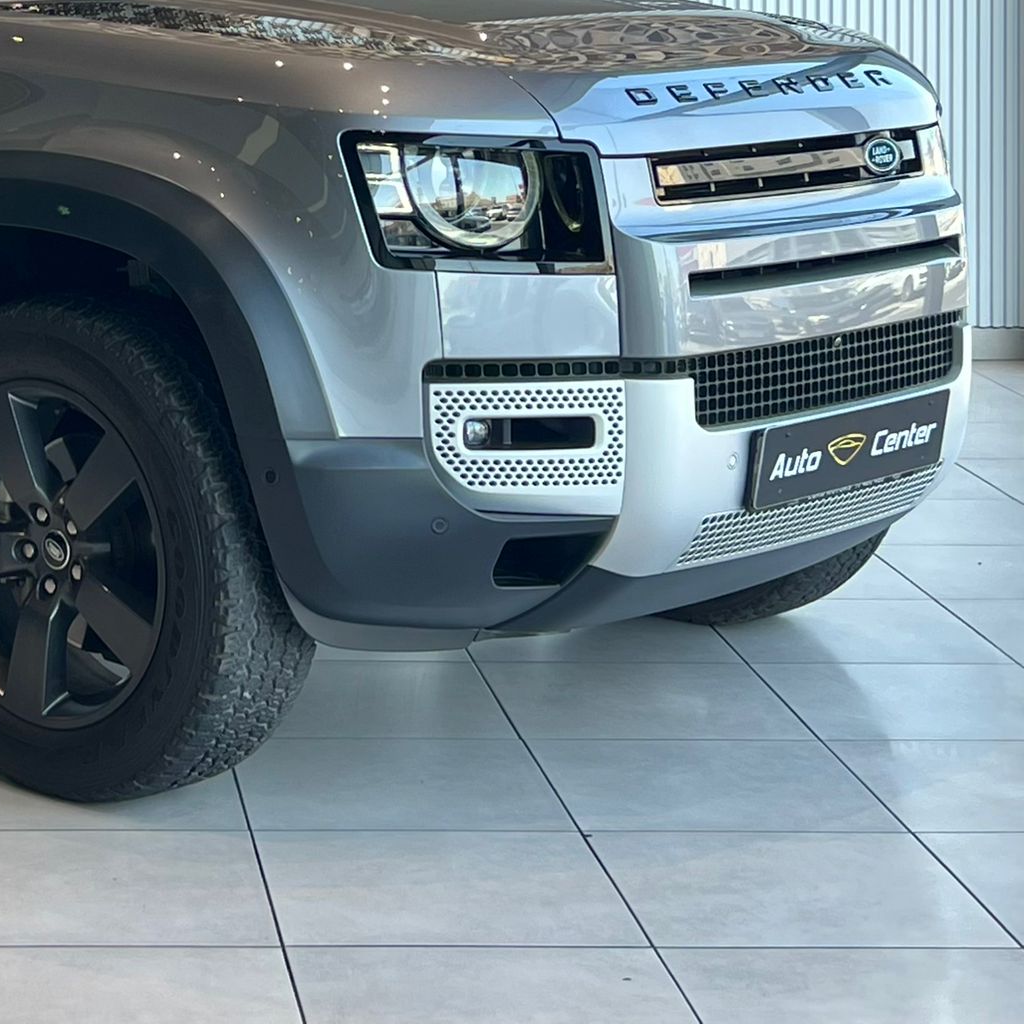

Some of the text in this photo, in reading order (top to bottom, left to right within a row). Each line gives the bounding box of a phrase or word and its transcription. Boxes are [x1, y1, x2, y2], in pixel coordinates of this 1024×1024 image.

[625, 70, 893, 105] DEFENDER
[769, 423, 937, 481] Auto Center
